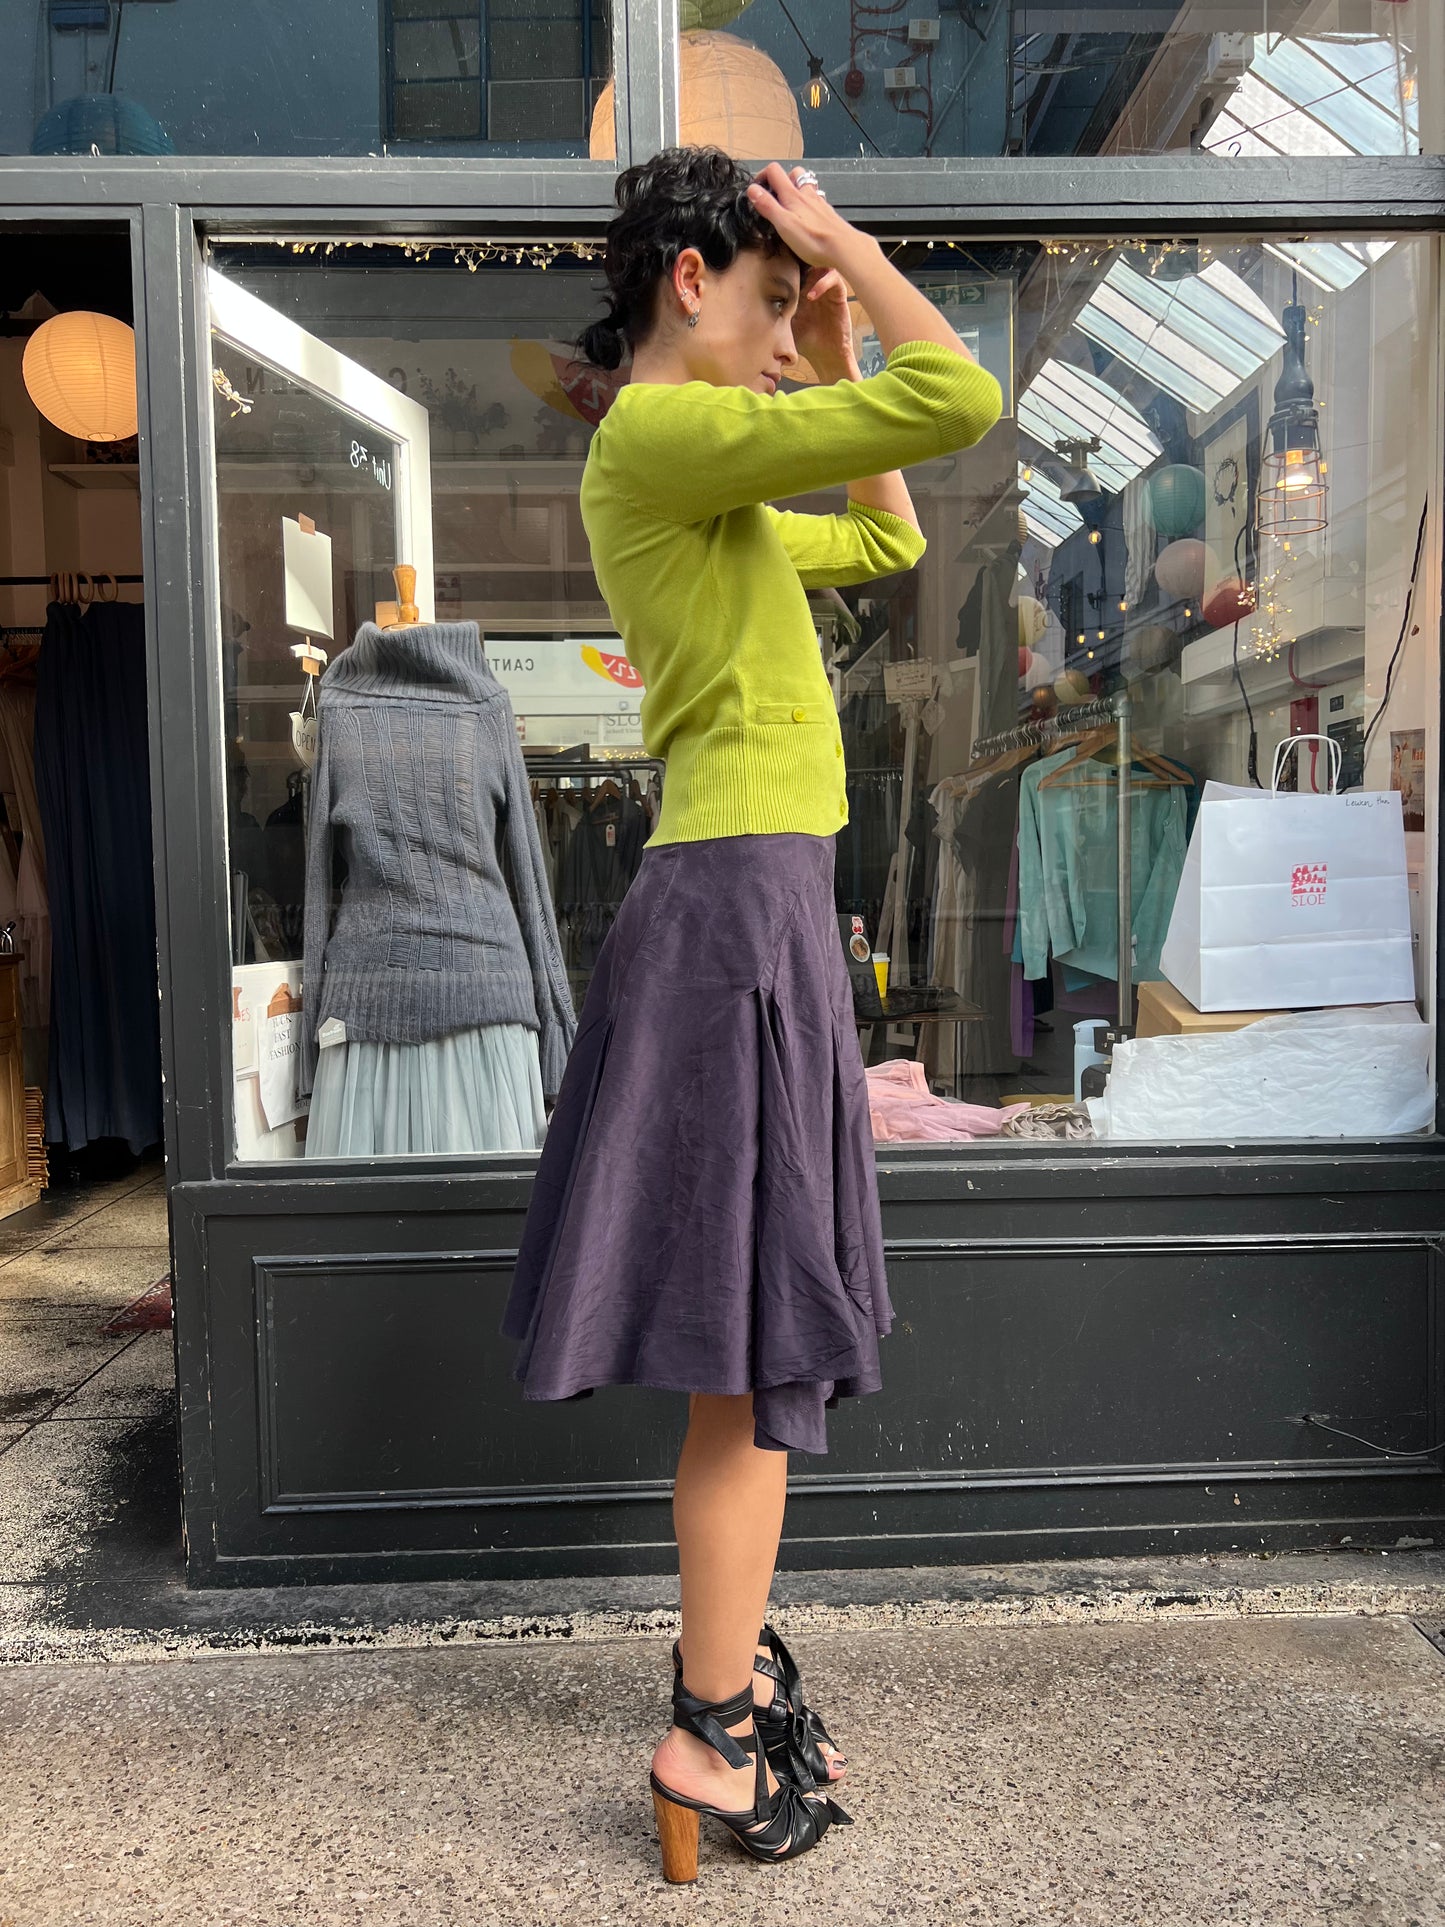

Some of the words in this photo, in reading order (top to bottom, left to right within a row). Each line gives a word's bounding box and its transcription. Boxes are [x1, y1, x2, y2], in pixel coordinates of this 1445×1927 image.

[1291, 893, 1326, 907] SLOE
[274, 1029, 292, 1043] FAST
[269, 1040, 302, 1061] FASHION
